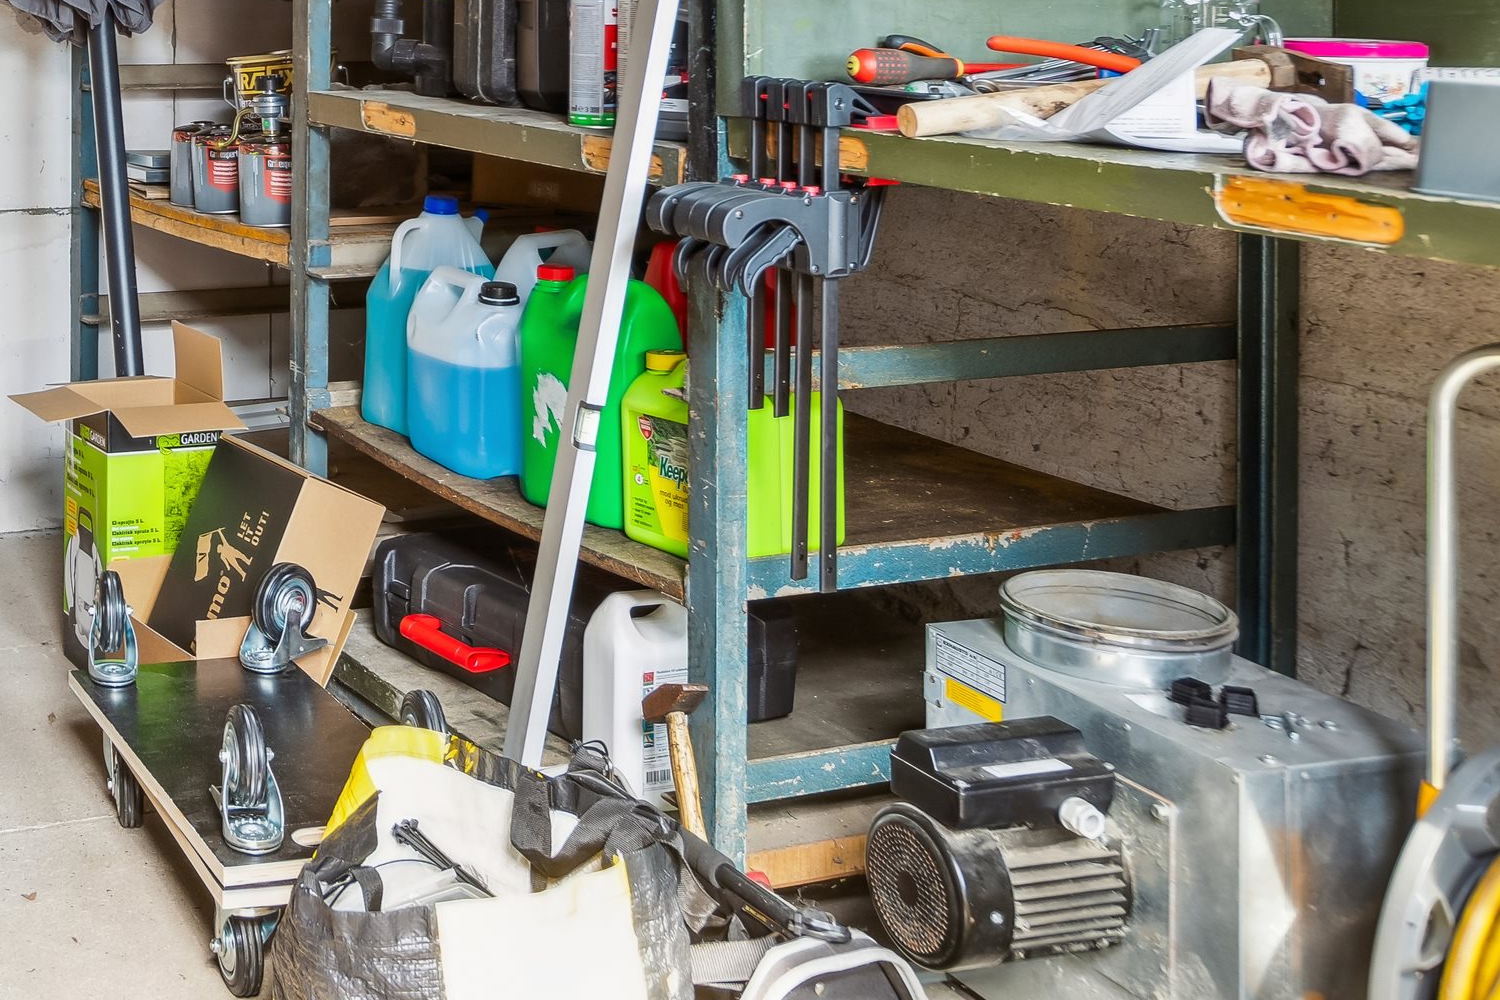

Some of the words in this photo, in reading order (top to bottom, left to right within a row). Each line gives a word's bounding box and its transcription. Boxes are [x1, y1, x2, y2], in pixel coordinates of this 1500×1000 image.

[90, 429, 106, 448] GARDEN
[180, 431, 218, 445] GARDEN
[237, 512, 252, 538] LET
[243, 526, 255, 543] IT
[251, 510, 270, 547] OUT!
